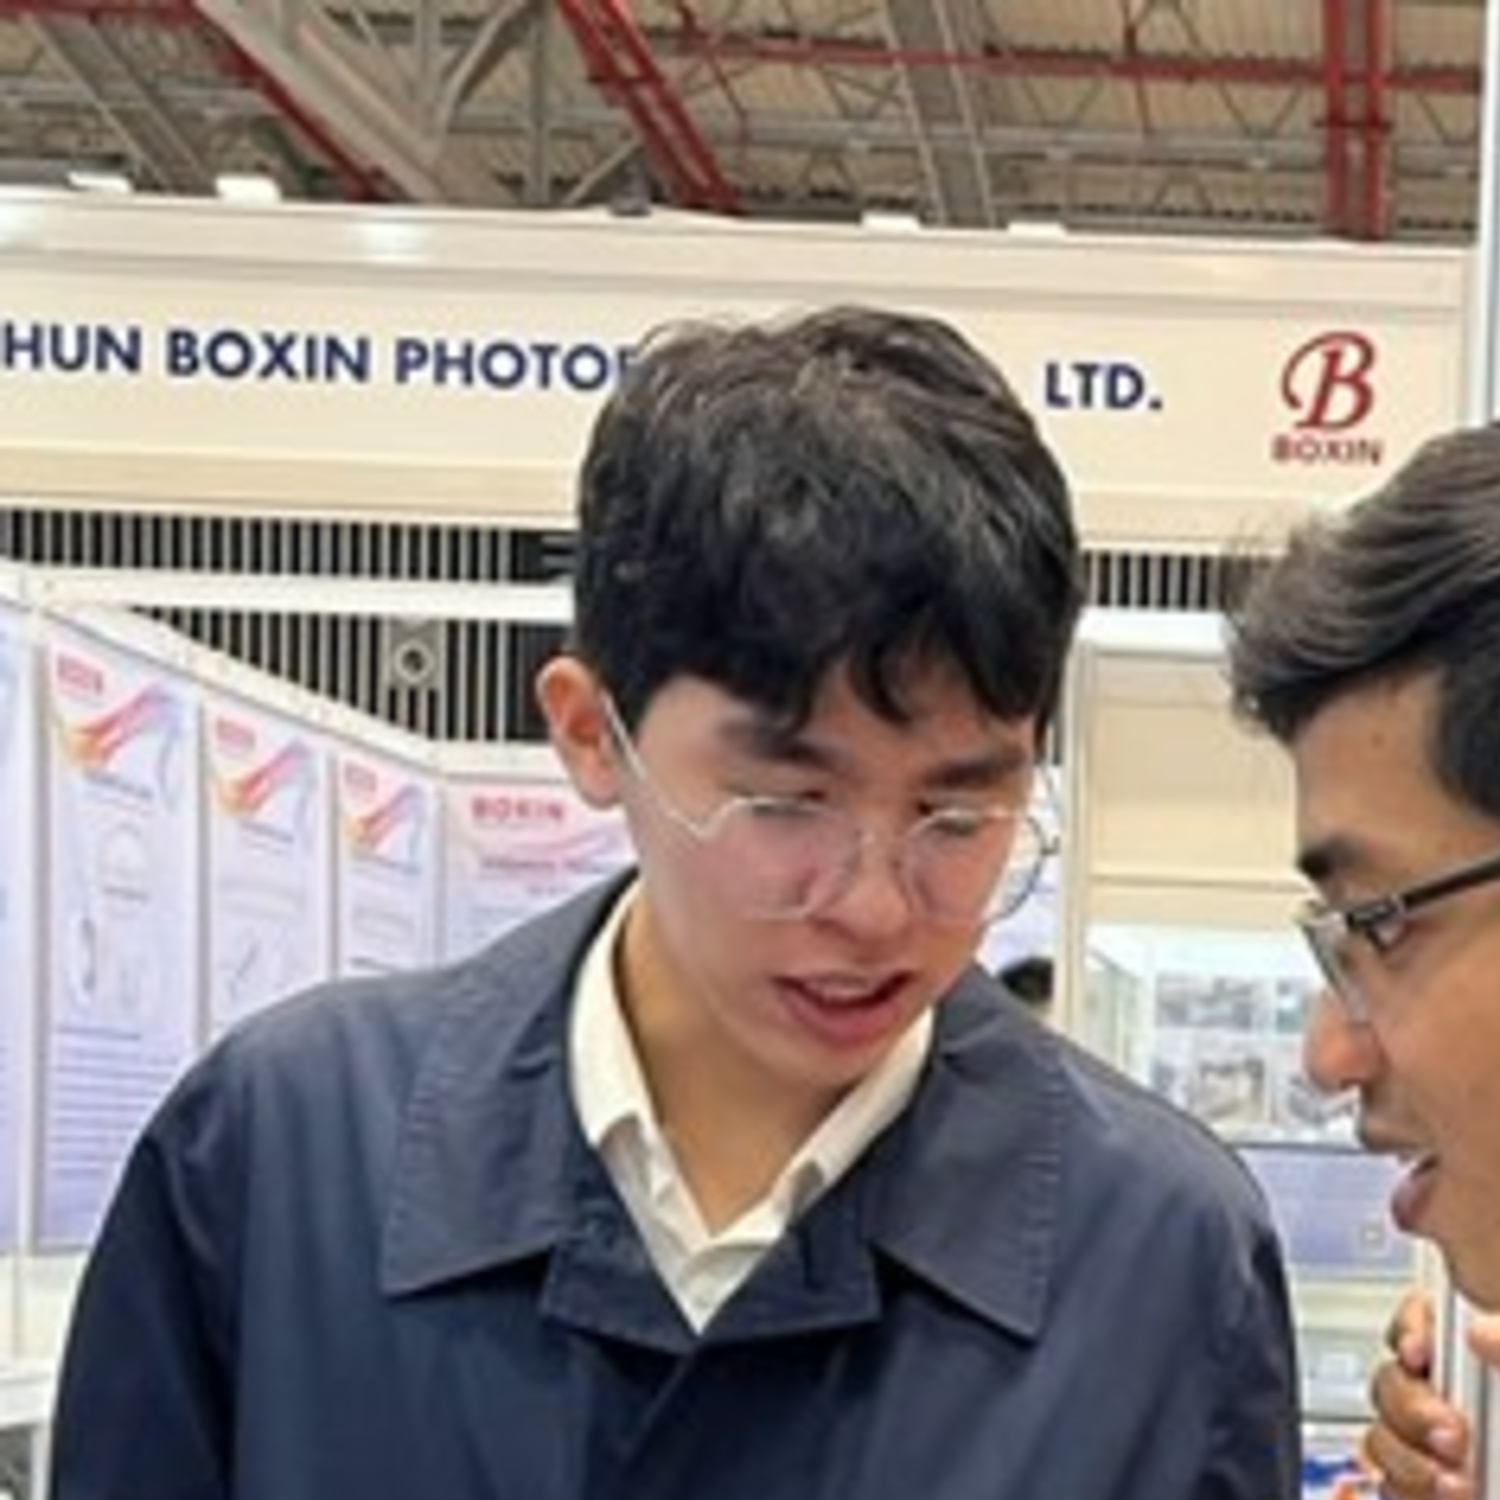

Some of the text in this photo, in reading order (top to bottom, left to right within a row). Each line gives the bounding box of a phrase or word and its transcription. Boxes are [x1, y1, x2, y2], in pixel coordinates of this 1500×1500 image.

[5, 320, 141, 374] HUN
[167, 329, 370, 383] BOXIN
[1045, 361, 1163, 410] LTD.
[1272, 434, 1383, 467] BOXIN
